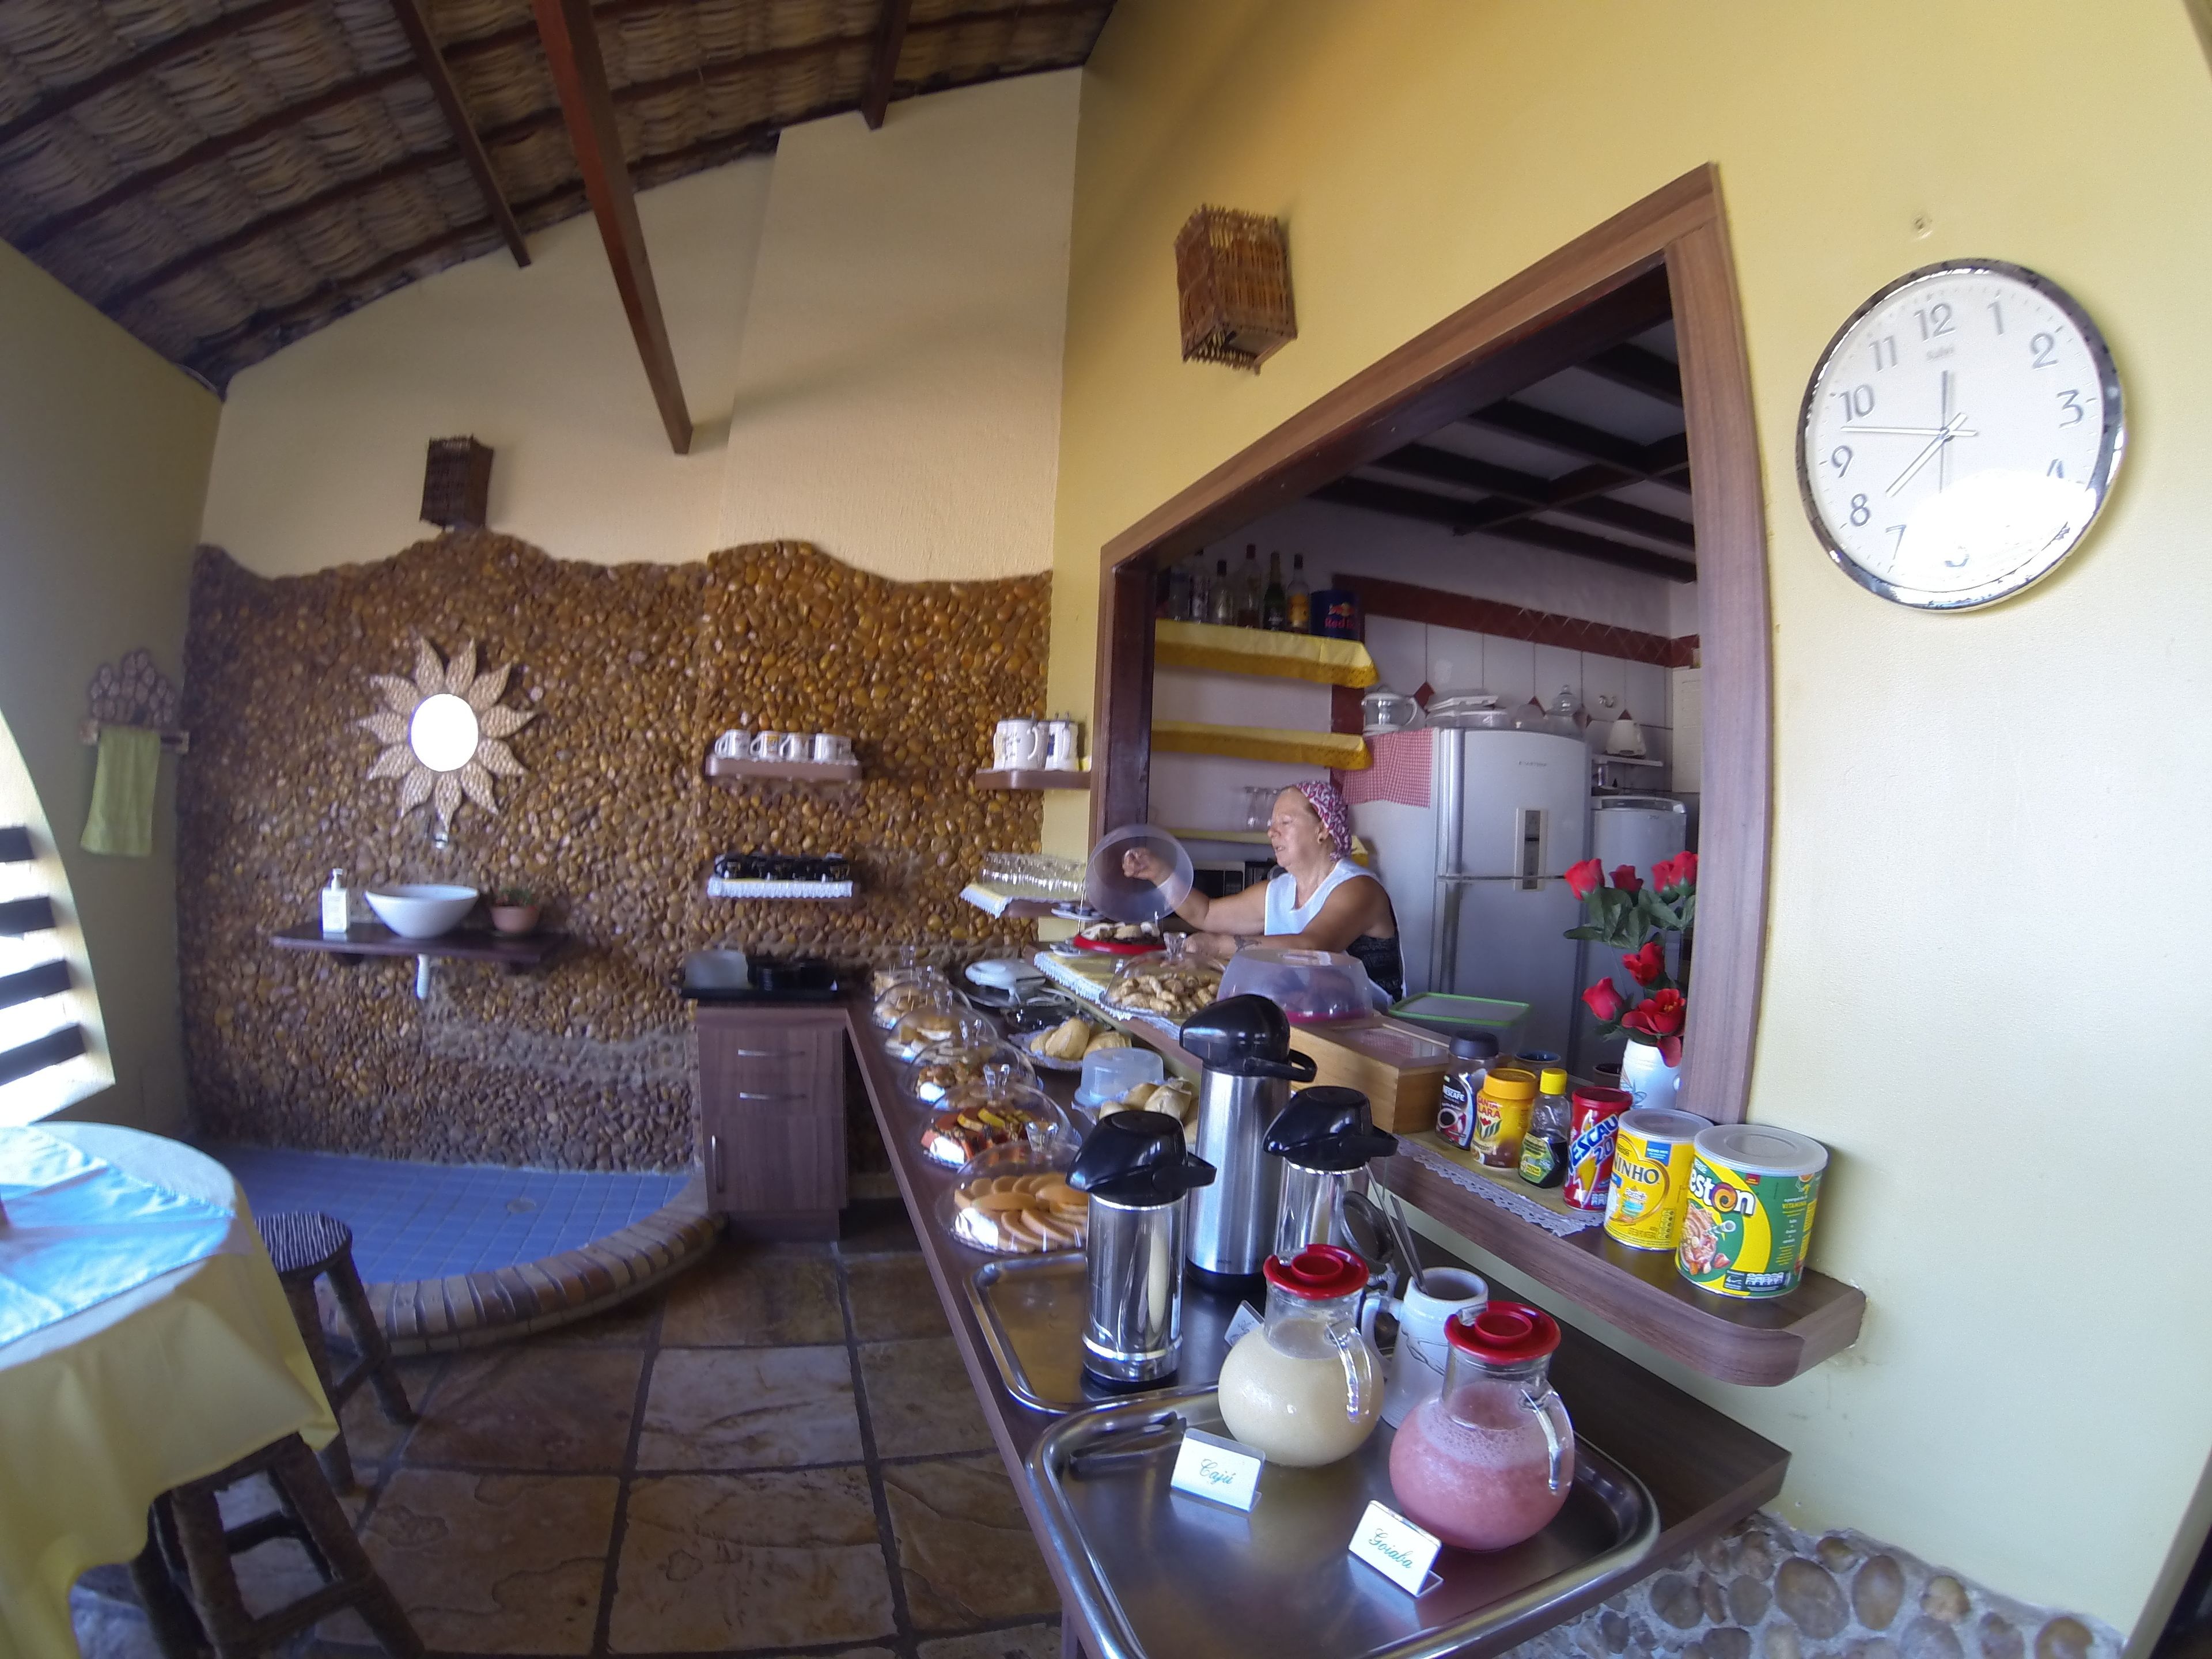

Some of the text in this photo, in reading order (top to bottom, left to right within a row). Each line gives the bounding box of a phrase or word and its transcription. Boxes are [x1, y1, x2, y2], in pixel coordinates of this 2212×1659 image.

[1914, 302, 1956, 342] 12
[1987, 301, 2006, 336] 1
[1869, 335, 1899, 373] 11
[2029, 332, 2059, 370] 2
[1838, 383, 1876, 424] 10
[2056, 389, 2085, 430] 3
[1831, 445, 1854, 479] 9
[1849, 493, 1872, 528] 8
[1884, 524, 1907, 560] 7
[1690, 1168, 1756, 1217] eston
[1199, 1458, 1237, 1485] Cajú
[1368, 1528, 1414, 1569] Goiaba
